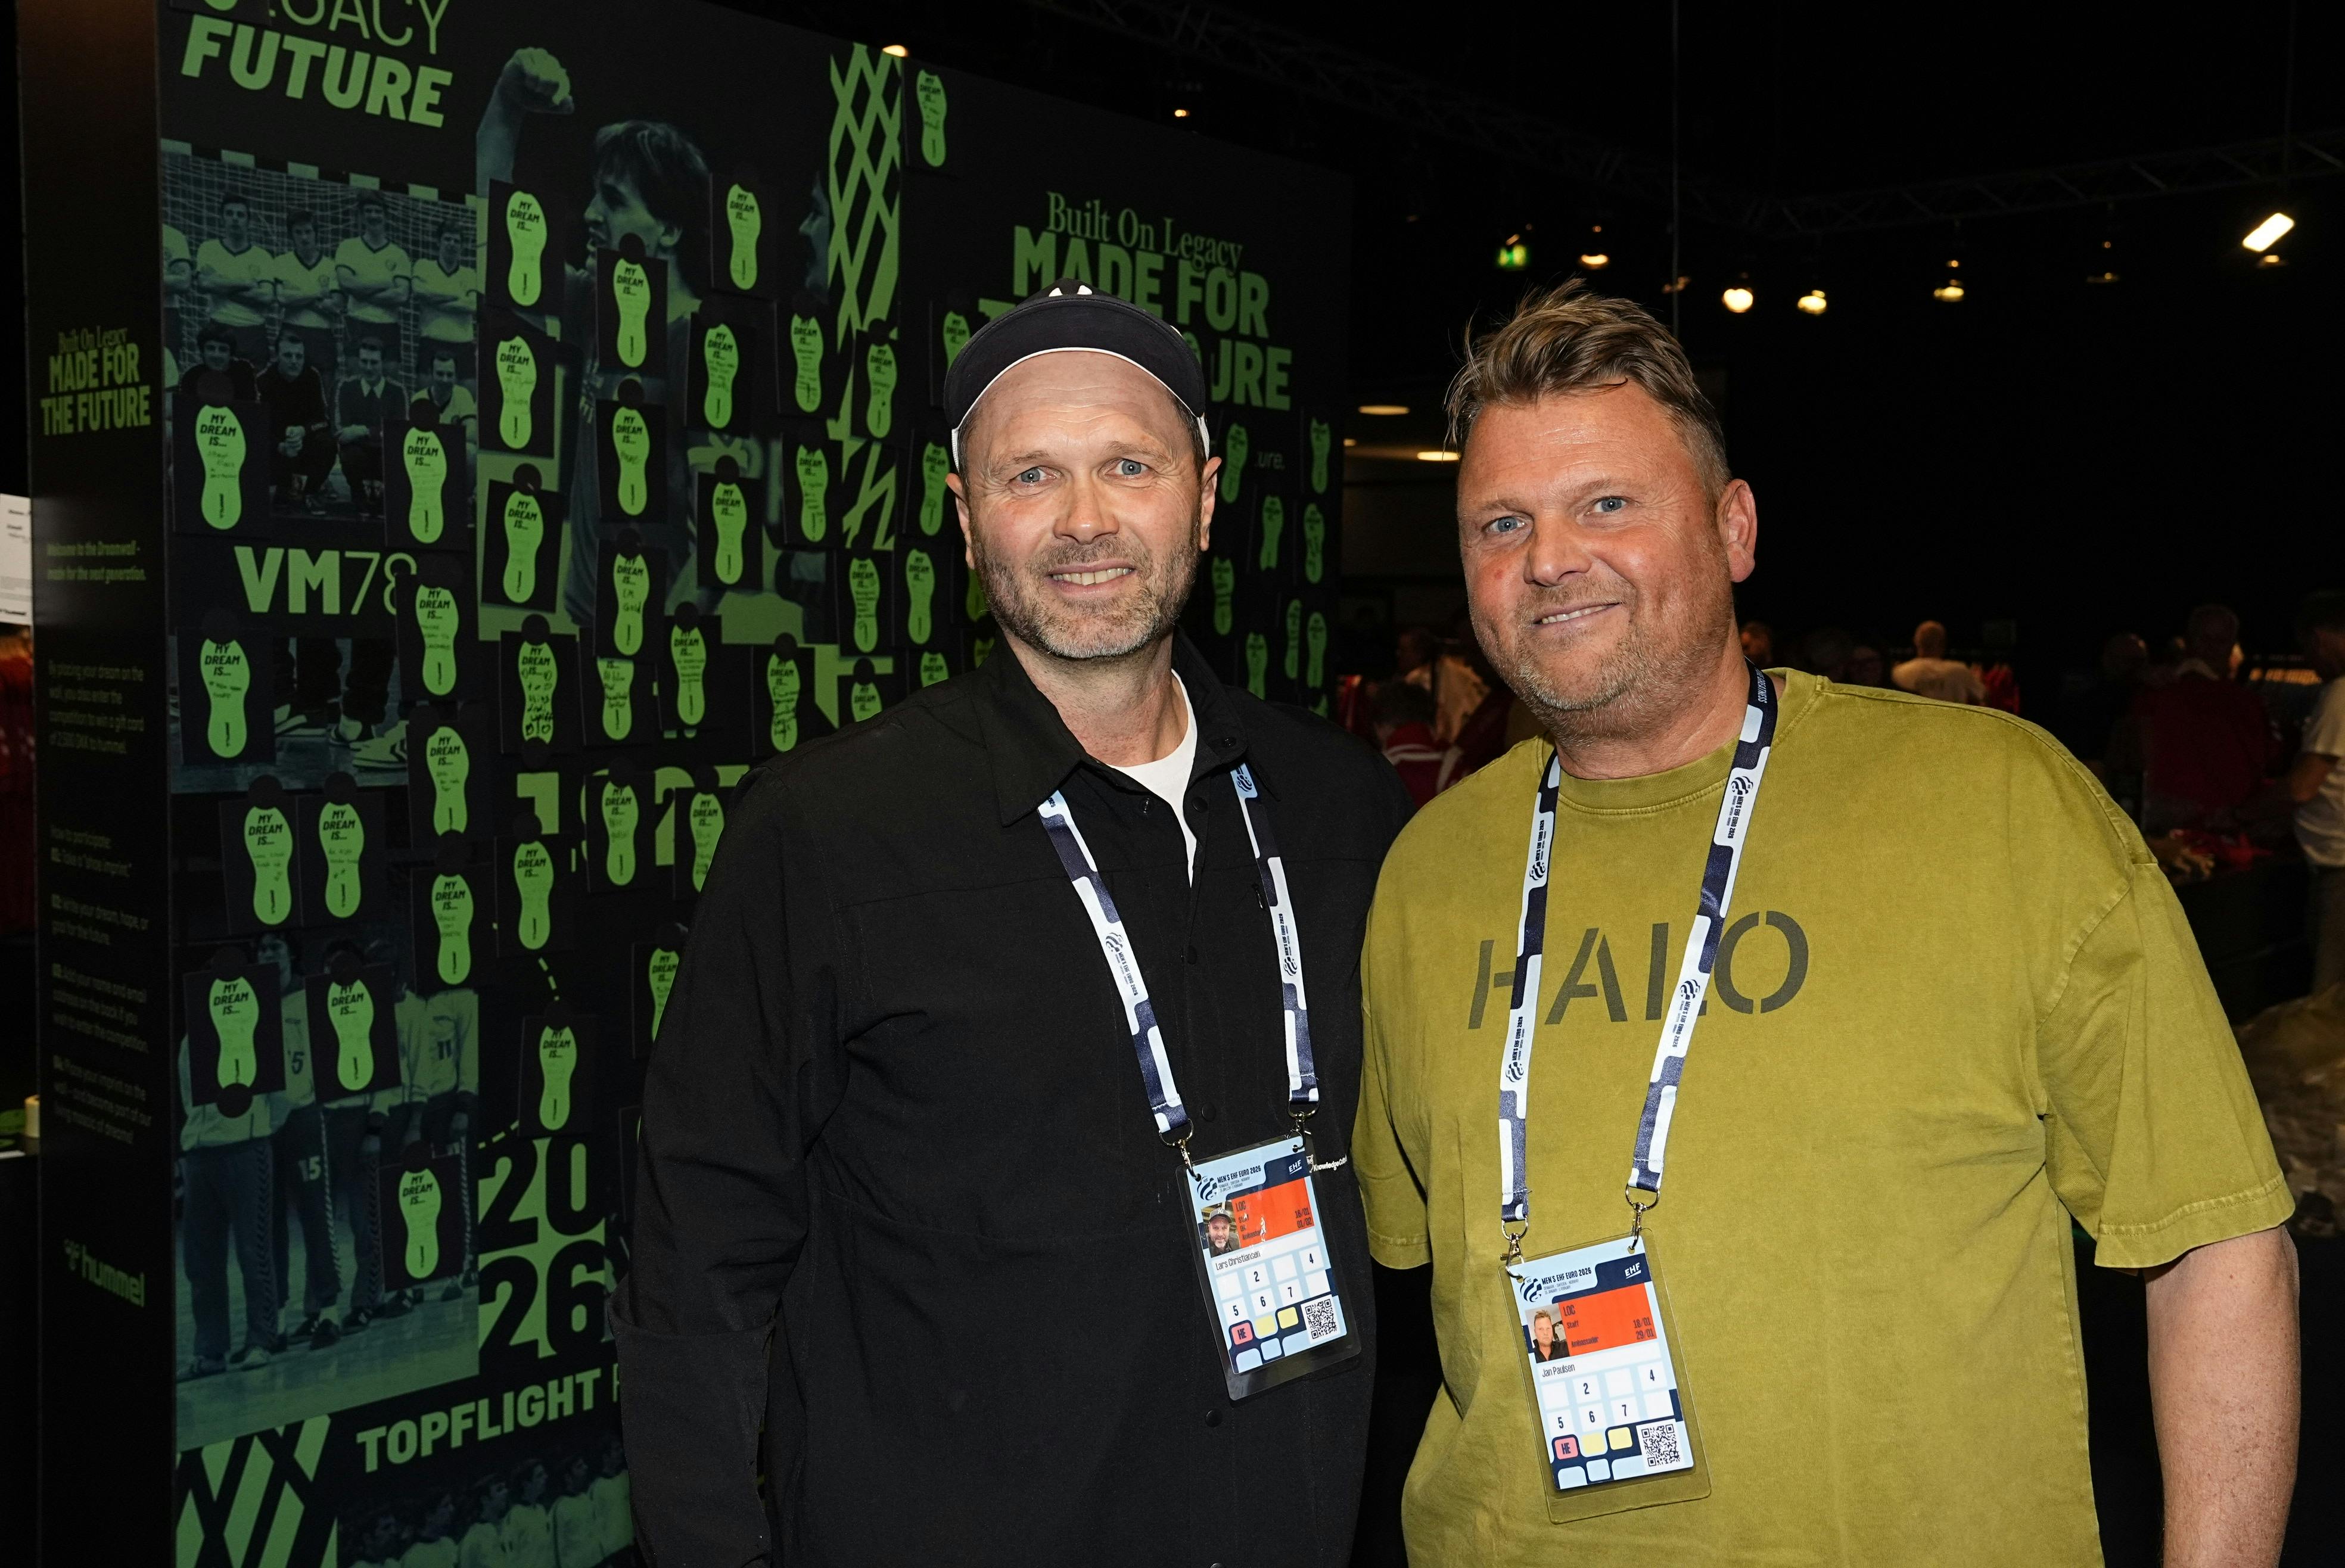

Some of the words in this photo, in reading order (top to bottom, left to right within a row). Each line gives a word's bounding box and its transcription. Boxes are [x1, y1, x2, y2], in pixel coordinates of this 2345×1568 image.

[181, 13, 453, 129] FUTURE
[519, 201, 531, 211] MY
[511, 209, 539, 223] DREAM
[1047, 191, 1111, 242] Built
[1118, 207, 1155, 251] On
[1164, 217, 1243, 276] Legacy
[625, 266, 636, 276] MY
[617, 275, 644, 287] DREAM
[1013, 225, 1164, 319] MADE
[1177, 259, 1270, 338] FOR
[509, 344, 521, 354] MY
[500, 353, 529, 366] DREAM
[49, 349, 99, 394] MADE
[102, 343, 141, 387] FOR
[39, 394, 74, 437] THE
[77, 384, 151, 433] FUTURE
[211, 414, 225, 425] MY
[624, 416, 636, 425] MY
[200, 424, 236, 436] DREAM
[616, 424, 643, 435] DREAM
[417, 437, 429, 446] MY
[407, 446, 438, 456] DREAM
[722, 489, 734, 498] MY
[517, 500, 530, 509] MY
[716, 497, 741, 508] DREAM
[508, 509, 537, 521] DREAM
[617, 565, 644, 576] DREAM
[429, 590, 441, 599] MY
[420, 599, 450, 609] DREAM
[214, 644, 229, 654] MY
[205, 655, 240, 665] DREAM
[438, 736, 452, 746] MY
[430, 745, 460, 756] DREAM
[613, 788, 624, 797] MY
[605, 797, 632, 806] DREAM
[258, 814, 272, 824] MY
[332, 810, 346, 820] MY
[248, 825, 283, 835] DREAM
[323, 820, 355, 830] DREAM
[526, 850, 539, 858] MY
[518, 858, 546, 867] DREAM
[444, 882, 458, 892] MY
[436, 891, 465, 901] DREAM
[1467, 910, 1810, 1030] HALO
[223, 983, 239, 994] MY
[340, 985, 354, 994] MY
[213, 993, 248, 1006] DREAM
[331, 993, 364, 1005] DREAM
[551, 1031, 564, 1040] MY
[543, 1040, 571, 1049] DREAM
[1289, 1160, 1302, 1173] EHF
[1230, 1171, 1239, 1180] EHF
[1239, 1169, 1249, 1177] EURO
[1250, 1165, 1261, 1174] 2026
[411, 1175, 424, 1185] MY
[403, 1184, 433, 1196] DREAM
[1215, 1261, 1229, 1271] Lars
[1229, 1250, 1261, 1267] Christiansen
[1254, 1271, 1259, 1282] 2
[1309, 1253, 1314, 1264] 4
[1625, 1262, 1640, 1276] EHF
[81, 1243, 144, 1307] hummel
[1556, 1273, 1566, 1282] EHF
[1566, 1270, 1578, 1280] EURO
[1579, 1267, 1591, 1276] 2026
[1233, 1305, 1239, 1316] 5
[1260, 1296, 1266, 1307] 6
[1287, 1287, 1293, 1298] 7
[1563, 1305, 1576, 1317] LOC
[1566, 1320, 1579, 1329] Staff
[1237, 1328, 1247, 1340] HE
[1636, 1329, 1654, 1340] 29/01
[1542, 1368, 1553, 1377] Jan
[1553, 1363, 1575, 1376] Paulsen
[1583, 1383, 1590, 1395] 2
[1650, 1369, 1655, 1382] 4
[356, 1367, 602, 1474] TOPFLIGHT
[1558, 1417, 1564, 1429] 5
[1589, 1411, 1596, 1423] 6
[1622, 1404, 1627, 1417] 7
[1561, 1442, 1571, 1455] HE
